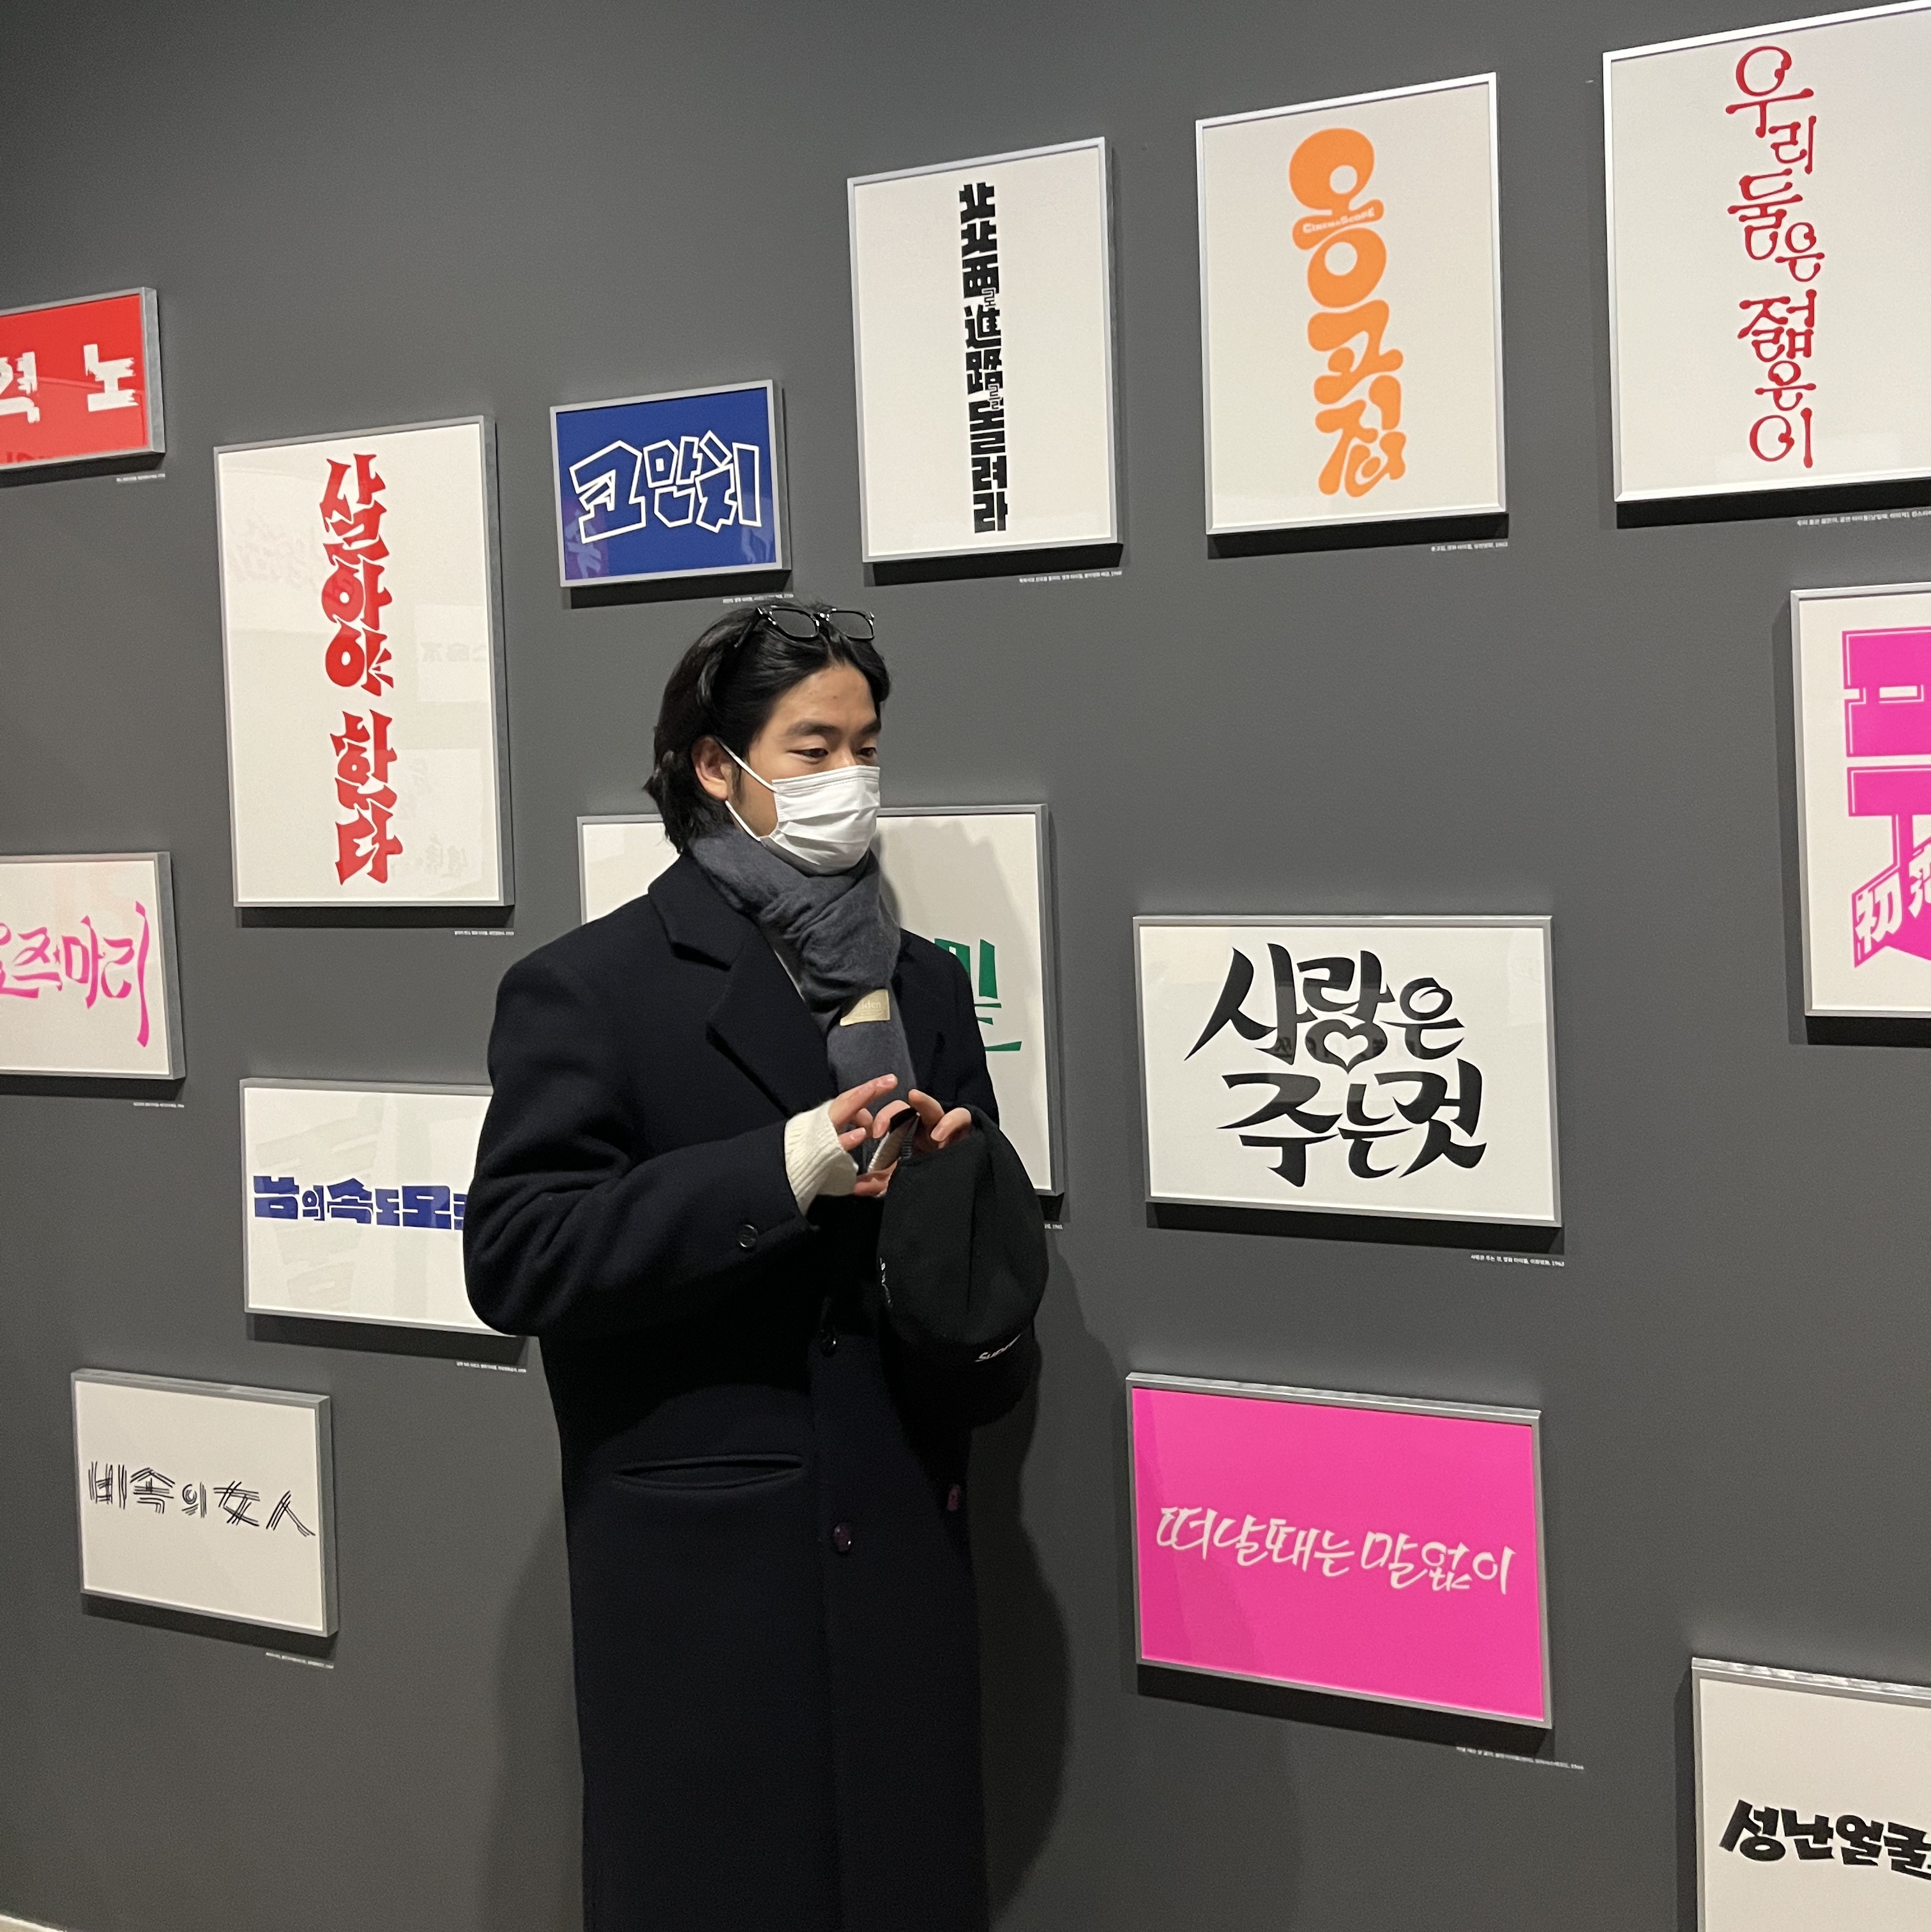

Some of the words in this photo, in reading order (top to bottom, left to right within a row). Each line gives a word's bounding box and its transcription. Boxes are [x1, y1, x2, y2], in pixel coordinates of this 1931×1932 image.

[84, 344, 139, 411] 노
[1289, 126, 1407, 498] 옹고집
[1738, 289, 1817, 468] 젊은이
[569, 430, 762, 544] 코만치
[329, 709, 403, 885] 한다
[1184, 942, 1465, 1074] 사랑은
[1156, 1506, 1355, 1578] 떠날때는
[1360, 1531, 1516, 1595] 말없이
